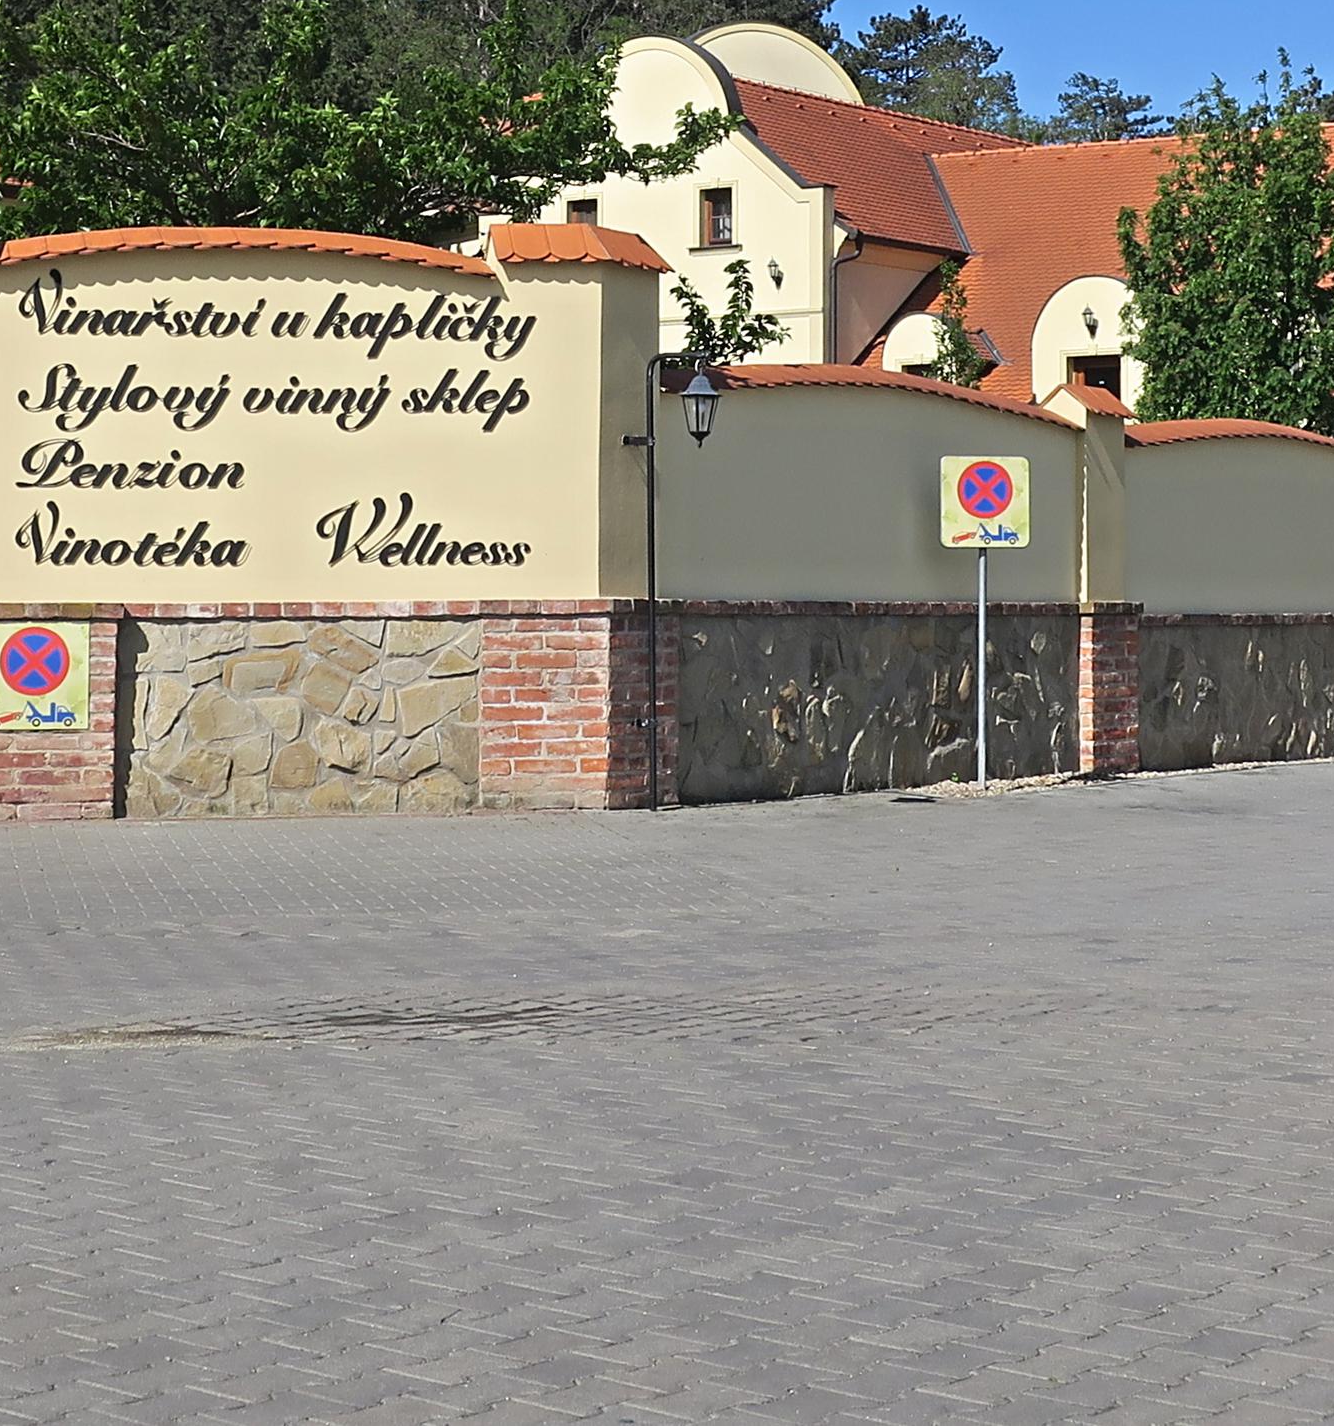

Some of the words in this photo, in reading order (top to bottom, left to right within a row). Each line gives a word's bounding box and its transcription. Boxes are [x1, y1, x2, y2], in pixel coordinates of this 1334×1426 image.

[18, 268, 267, 337] Vinařství
[270, 311, 311, 338] u
[313, 292, 537, 361] kapličky
[17, 363, 232, 432] Stylový
[242, 374, 391, 432] vinný
[401, 368, 530, 433] sklep
[15, 438, 245, 489] Penzion
[15, 500, 253, 567] Vinotéka
[316, 492, 532, 567] Wellness
